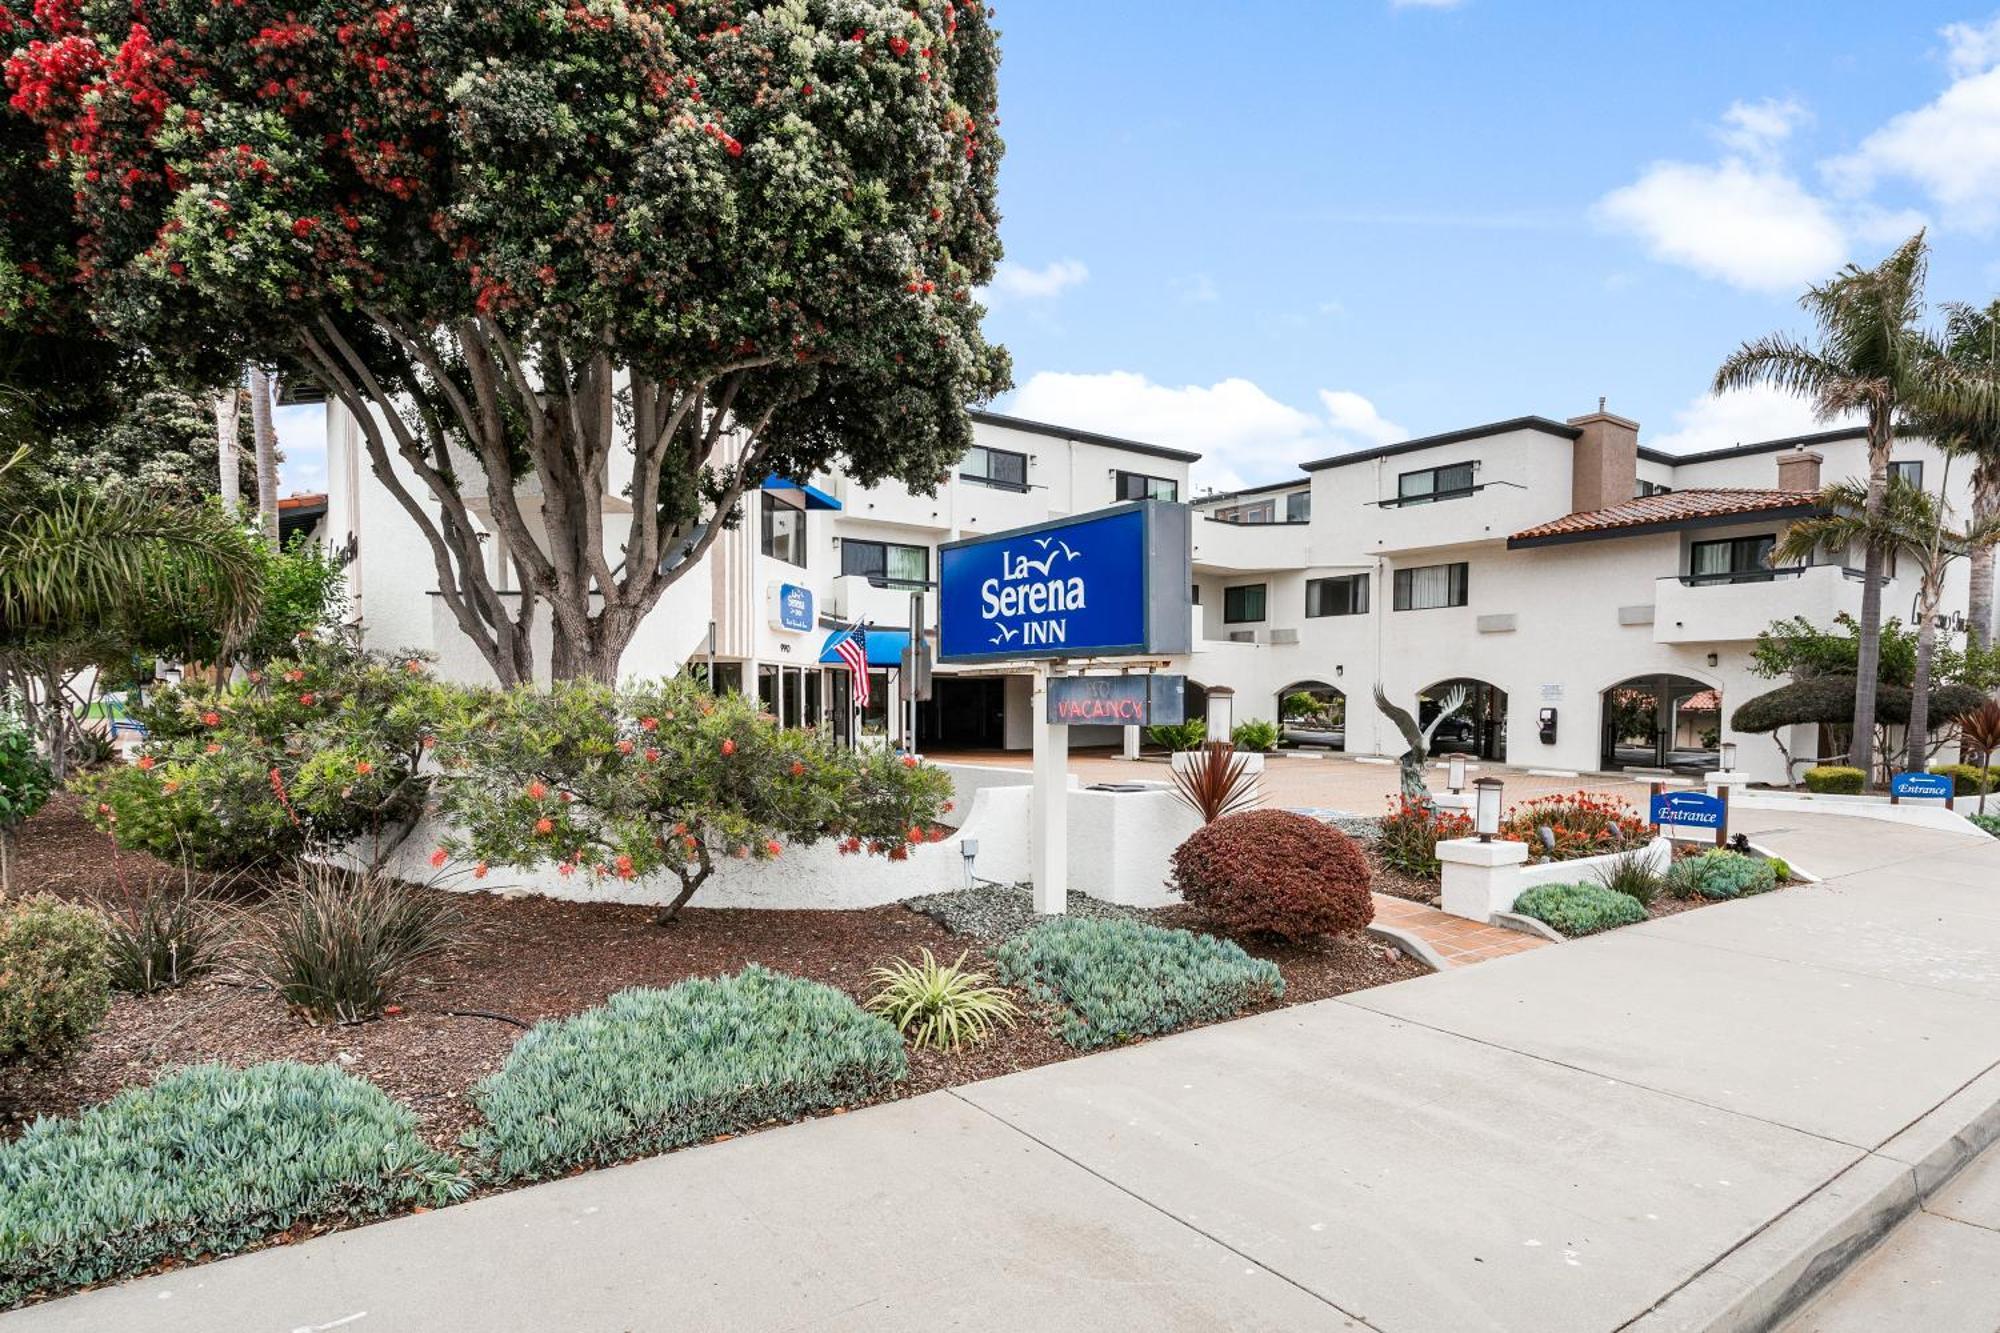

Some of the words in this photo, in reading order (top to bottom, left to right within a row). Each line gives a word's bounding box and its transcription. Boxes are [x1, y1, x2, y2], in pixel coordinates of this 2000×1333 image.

[1002, 550, 1029, 580] La
[981, 577, 1086, 619] Serena
[1023, 618, 1066, 645] INN
[1059, 699, 1143, 721] VACANCY
[1898, 783, 1946, 795] Entrance
[1658, 807, 1717, 823] Entrance
